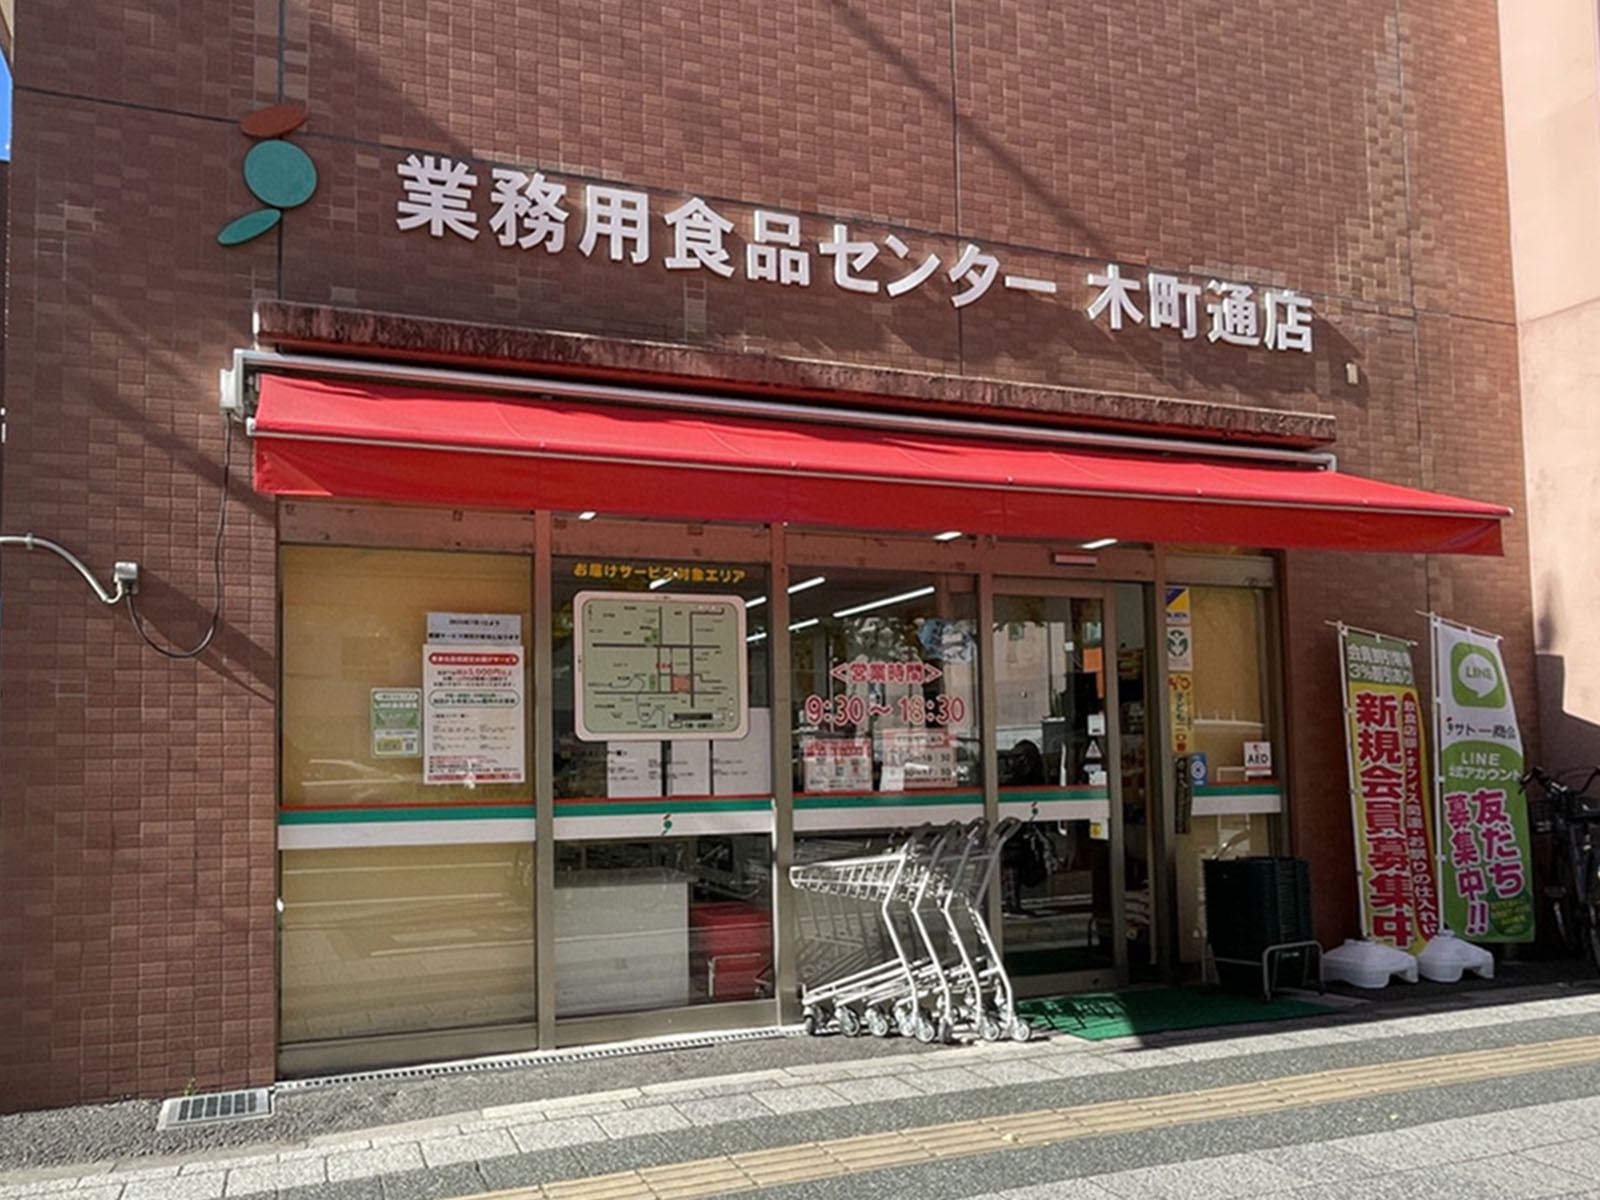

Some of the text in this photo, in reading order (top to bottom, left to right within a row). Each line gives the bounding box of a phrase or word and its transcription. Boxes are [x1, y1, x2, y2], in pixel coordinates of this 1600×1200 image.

[396, 154, 1314, 353] 業務用食品センター 木町通店
[1465, 665, 1493, 681] LINE
[1247, 754, 1269, 765] AED
[1460, 751, 1500, 766] LINE
[1355, 691, 1414, 948] 新規会員募集中
[1471, 787, 1525, 899] 友だち
